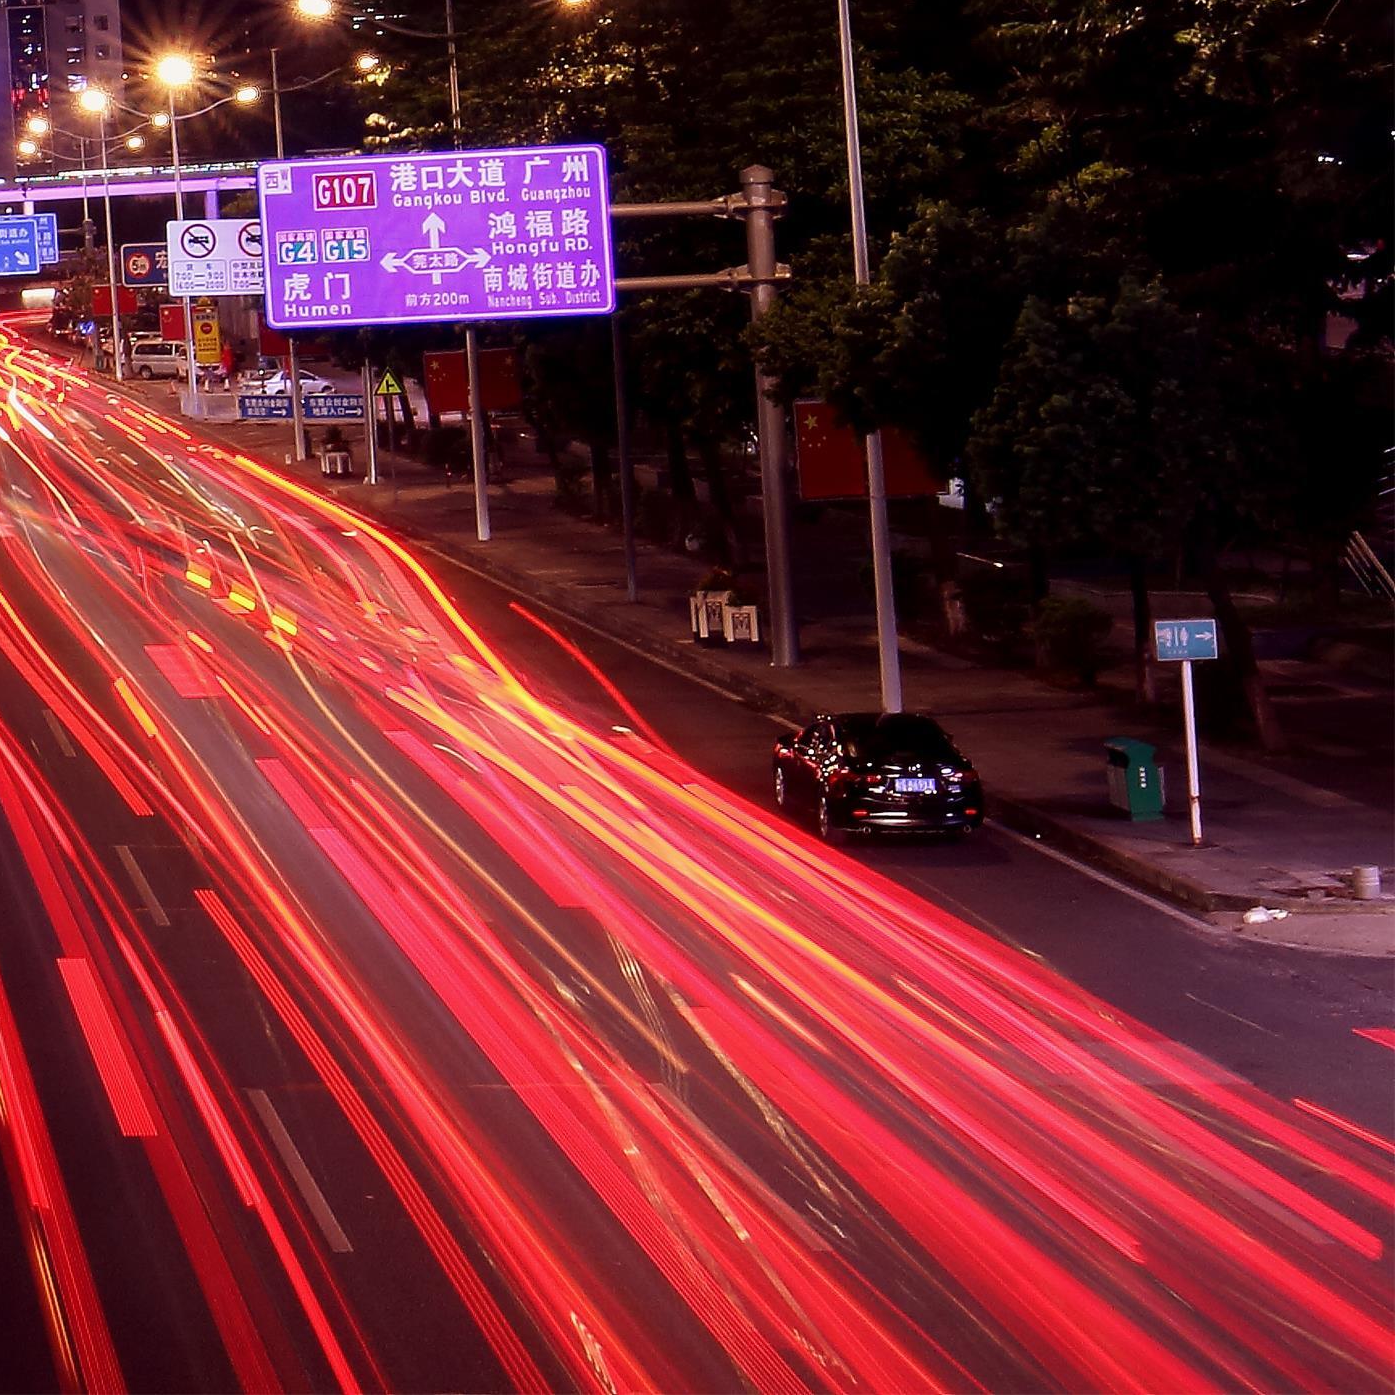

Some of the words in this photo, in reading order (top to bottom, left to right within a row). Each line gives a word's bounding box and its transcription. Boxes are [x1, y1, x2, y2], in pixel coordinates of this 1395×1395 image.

[389, 158, 506, 191] 港口大道
[523, 154, 589, 184] 广州
[317, 177, 371, 205] G107
[393, 192, 462, 209] Gangkou
[470, 188, 510, 204] Blvd.
[521, 186, 591, 203] Guangzhou
[488, 208, 590, 239] 鸿福路
[281, 241, 314, 262] G4
[326, 239, 367, 261] G15
[491, 239, 559, 257] Hongfu
[564, 237, 593, 252] RD.
[413, 254, 460, 269] 莞太路
[283, 272, 351, 302] 虎门
[483, 259, 601, 293] 南城街道办
[487, 295, 532, 309] Nancheng
[566, 290, 601, 304] District
[284, 304, 352, 318] Humen
